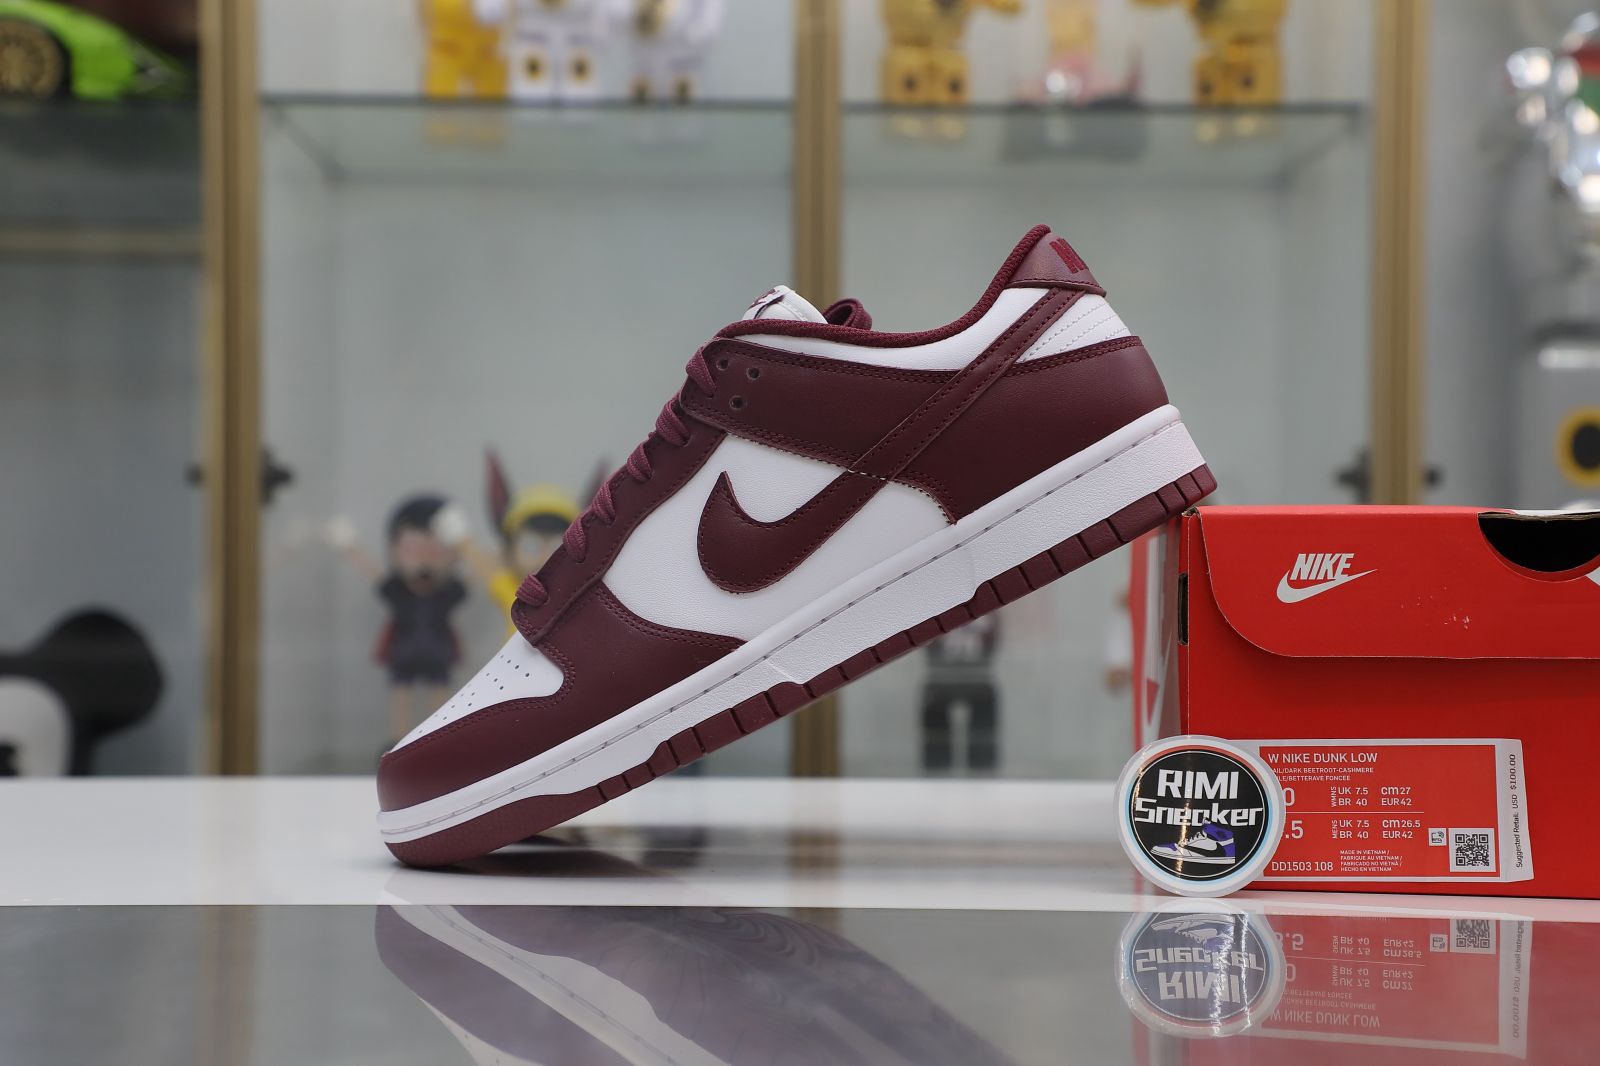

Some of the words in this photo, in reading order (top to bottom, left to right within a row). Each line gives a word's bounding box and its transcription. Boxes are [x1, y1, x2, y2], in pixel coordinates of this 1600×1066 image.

[1290, 553, 1354, 580] NIKE
[1268, 754, 1279, 763] W
[1282, 754, 1310, 763] NIKE
[1313, 753, 1348, 762] DUNK
[1351, 753, 1377, 762] LOW
[1158, 769, 1239, 799] RIMI
[1282, 787, 1295, 806] 0
[1285, 820, 1304, 839] .5
[1514, 834, 1523, 868] Suggested
[1271, 862, 1312, 871] DD1503
[1314, 861, 1334, 871] 108
